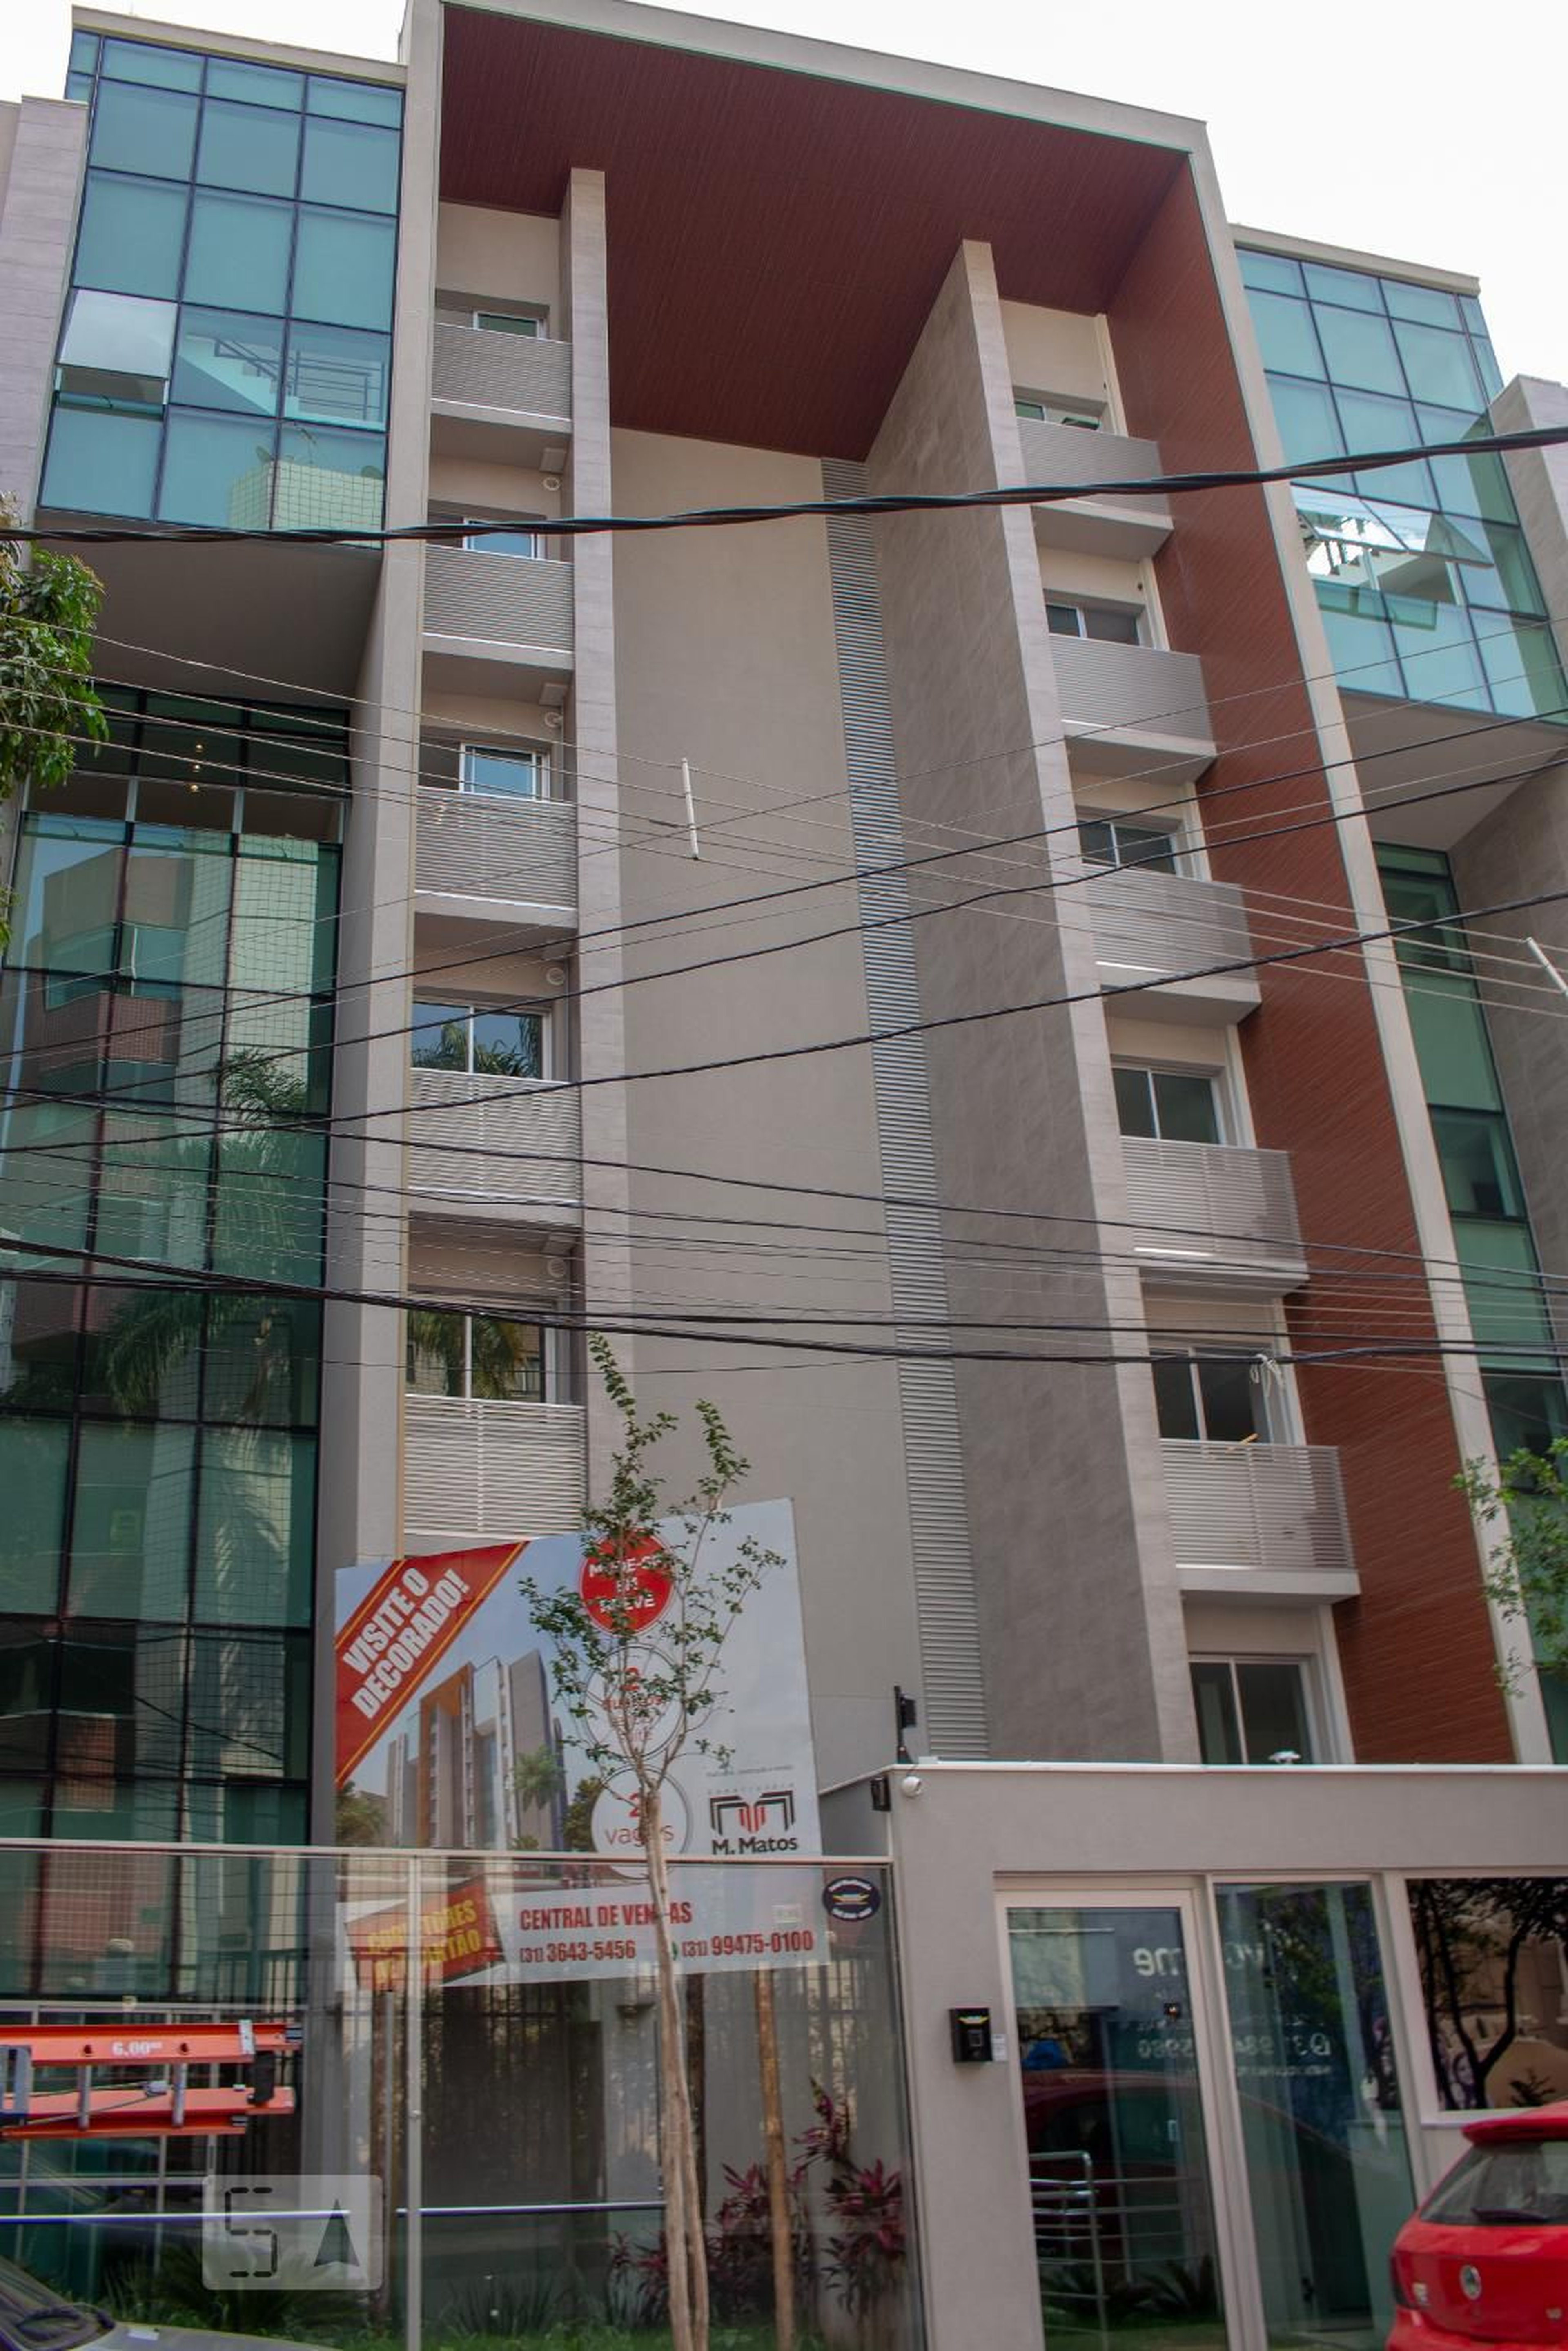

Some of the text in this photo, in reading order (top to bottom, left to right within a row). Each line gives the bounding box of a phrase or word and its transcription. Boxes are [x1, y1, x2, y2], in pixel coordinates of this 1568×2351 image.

[342, 1568, 430, 1674] VISITE O
[351, 1568, 470, 1720] DECORADO!
[604, 1825, 674, 1847] vags
[712, 1837, 798, 1855] M. Matos
[520, 1901, 693, 1931] CENTRAL DE VENAS
[546, 1939, 636, 1962] 3643-5456
[712, 1930, 814, 1956] 99475-0100
